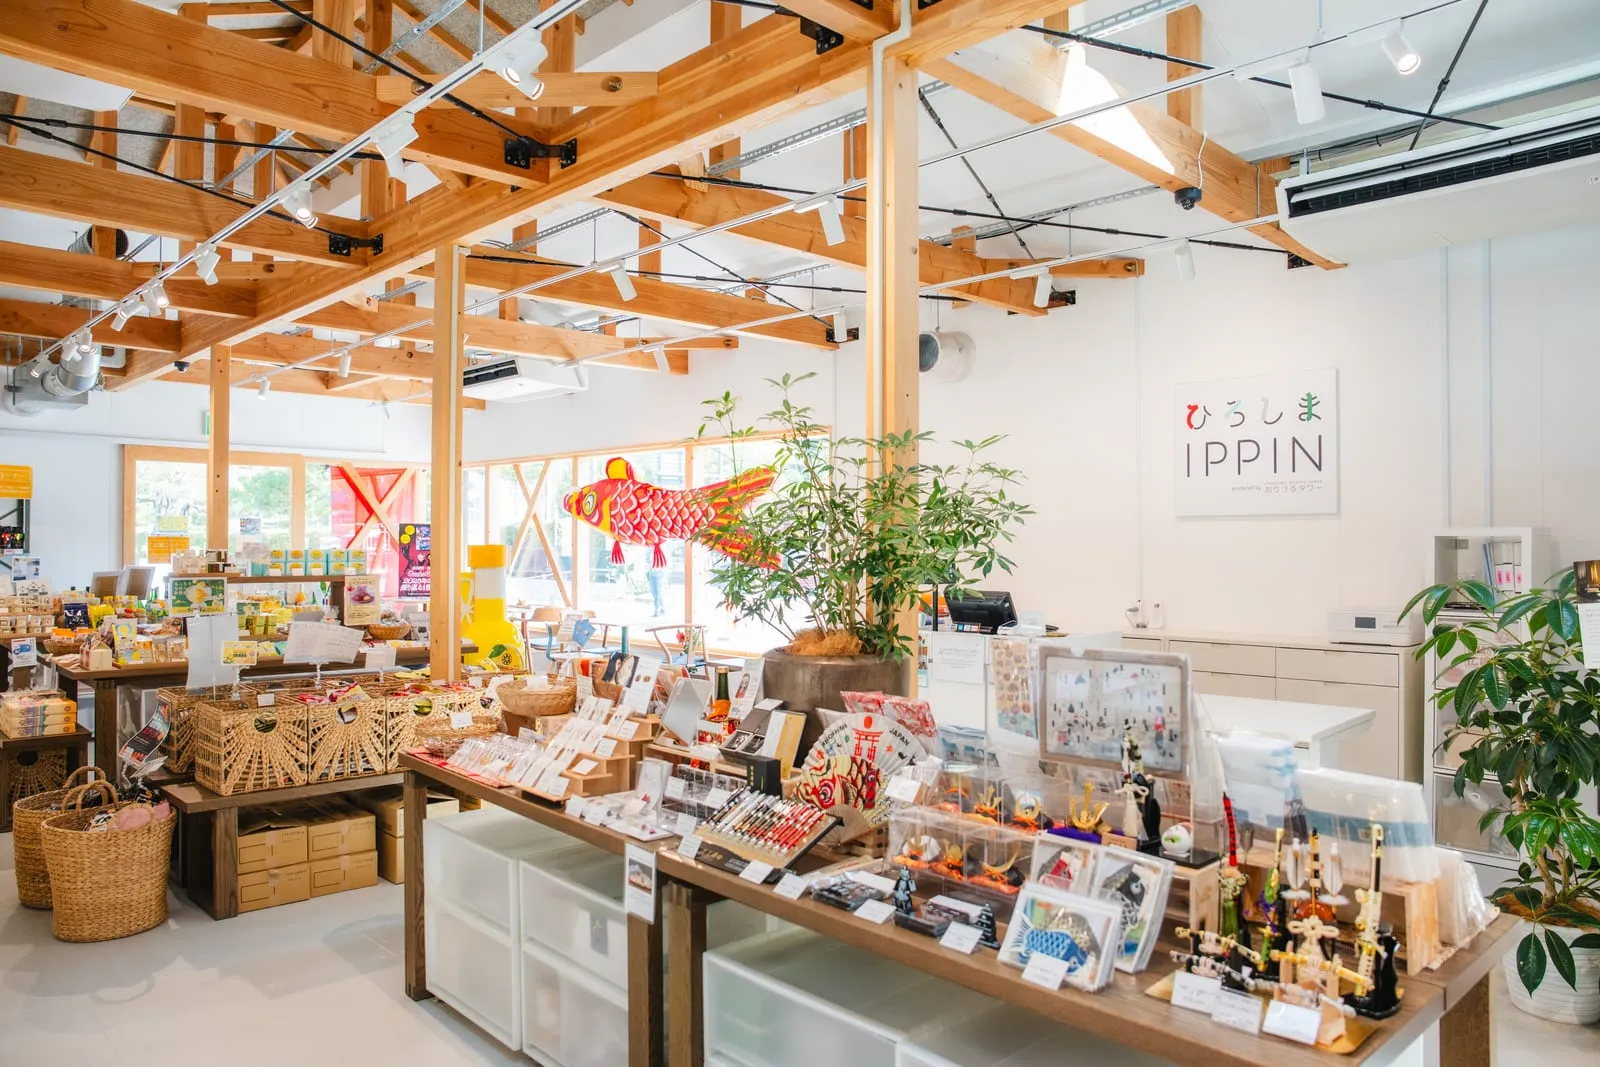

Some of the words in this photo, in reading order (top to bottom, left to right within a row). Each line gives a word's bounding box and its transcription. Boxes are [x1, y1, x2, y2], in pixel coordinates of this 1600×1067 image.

[1186, 392, 1322, 430] ひろしま
[1187, 434, 1322, 478] IPPIN
[889, 728, 909, 746] JAPAN
